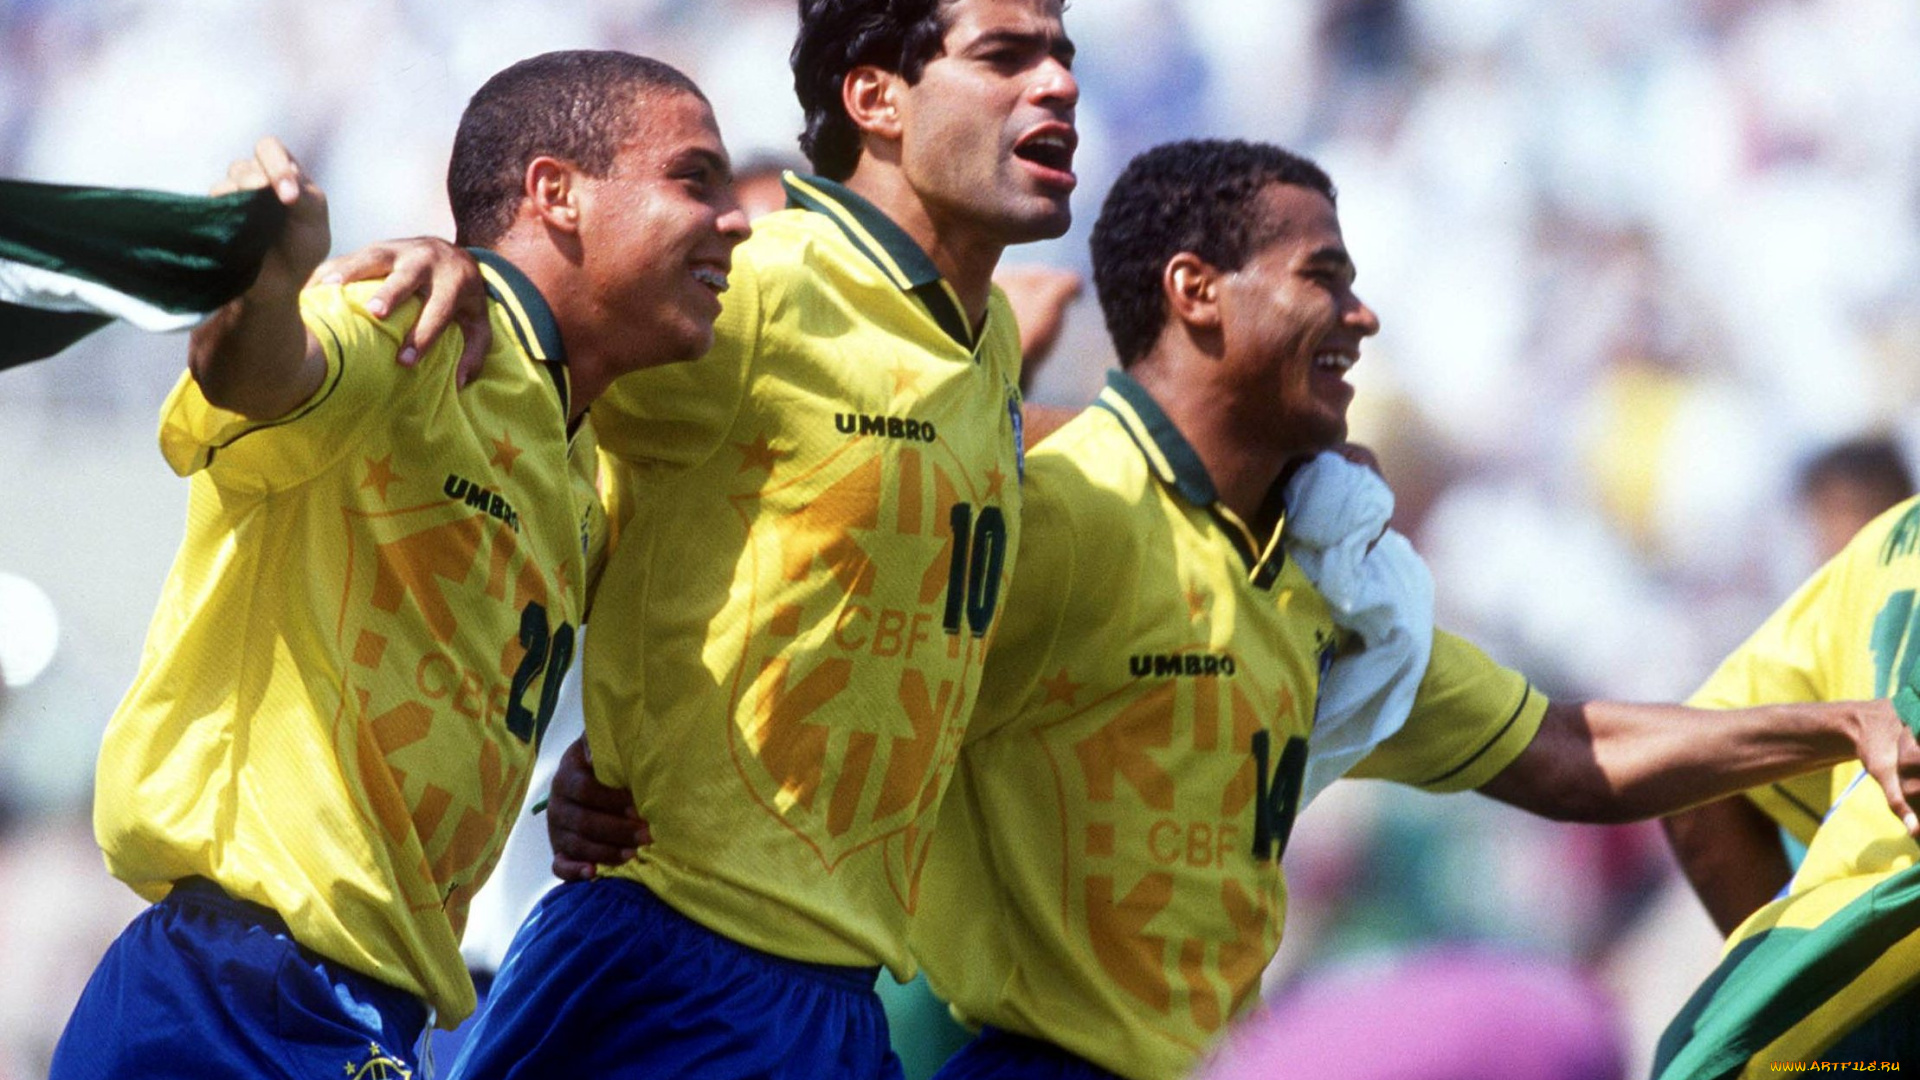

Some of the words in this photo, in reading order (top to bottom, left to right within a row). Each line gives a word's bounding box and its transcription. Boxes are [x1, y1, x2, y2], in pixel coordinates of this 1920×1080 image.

[835, 413, 936, 443] UMBRO
[943, 502, 1007, 638] 10
[834, 604, 932, 660] CBF
[1129, 654, 1236, 677] UMBRO
[1252, 728, 1308, 864] 14
[1149, 819, 1239, 868] CBF
